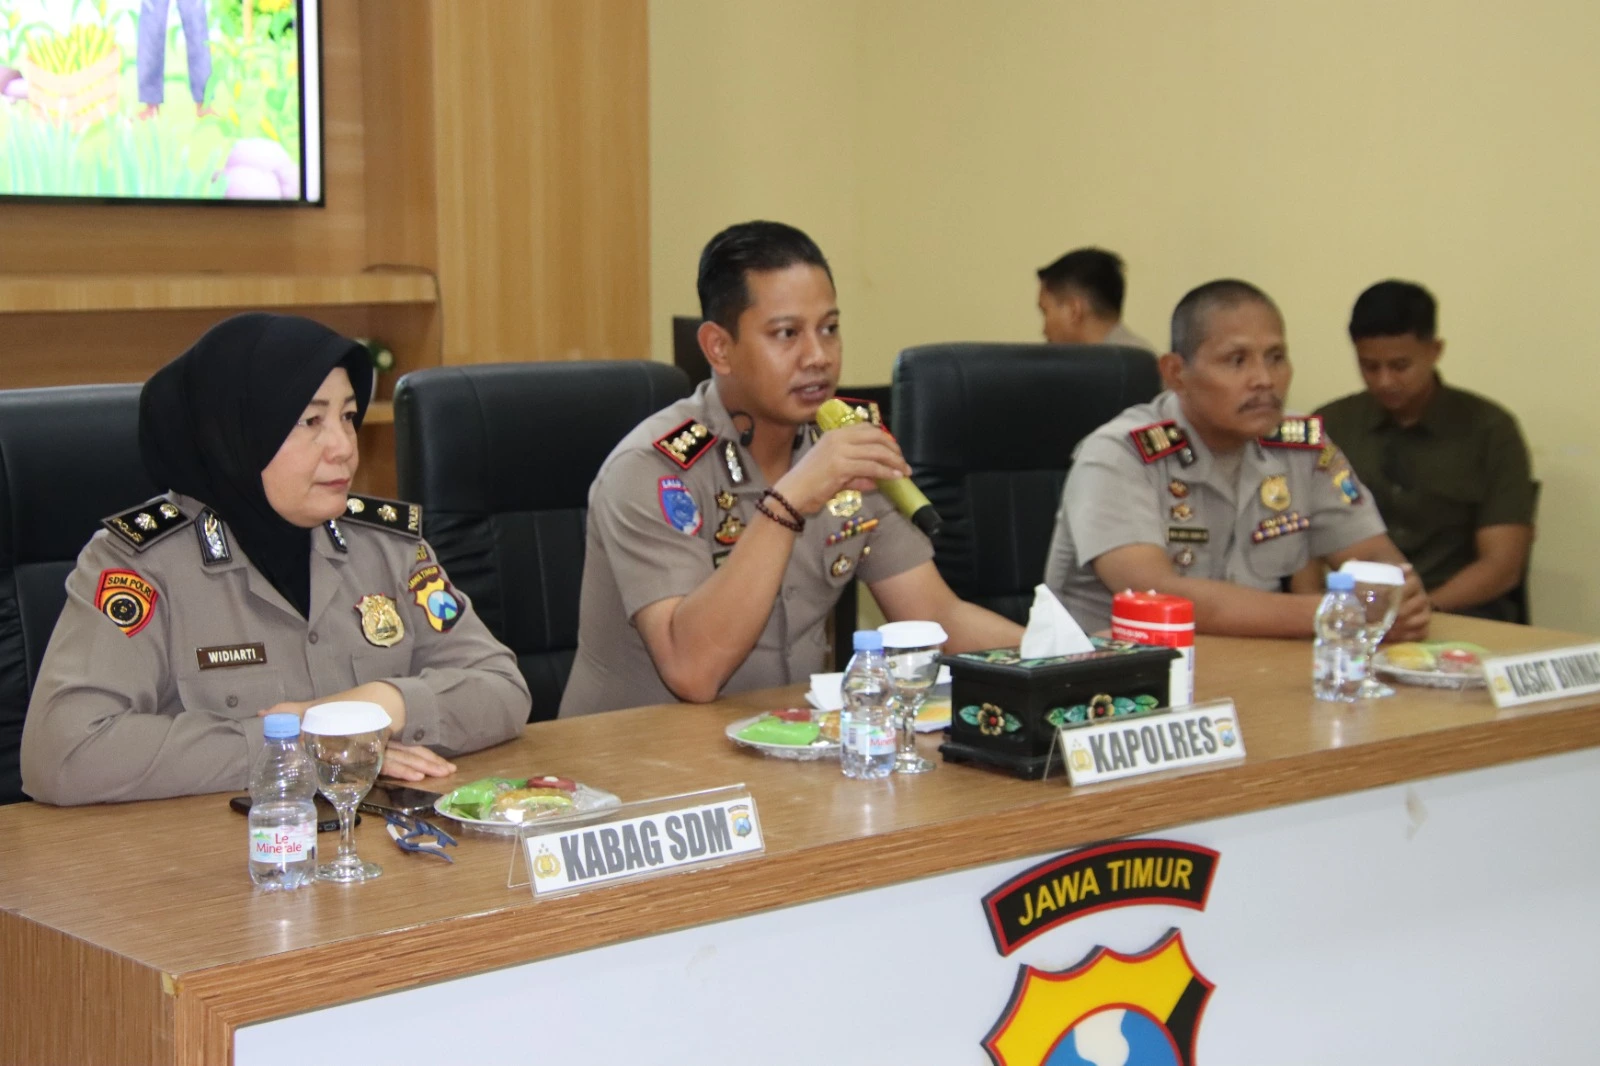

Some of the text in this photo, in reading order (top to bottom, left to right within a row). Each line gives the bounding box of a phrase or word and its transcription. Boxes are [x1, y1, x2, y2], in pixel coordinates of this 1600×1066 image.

[107, 576, 129, 586] SDM
[208, 648, 256, 663] WIDIARTI
[1088, 716, 1218, 773] KAPOLRES
[275, 833, 289, 845] Le
[559, 807, 733, 882] KABAG SDM
[256, 842, 302, 854] Minerale
[1018, 857, 1193, 926] JAWA TIMUR
